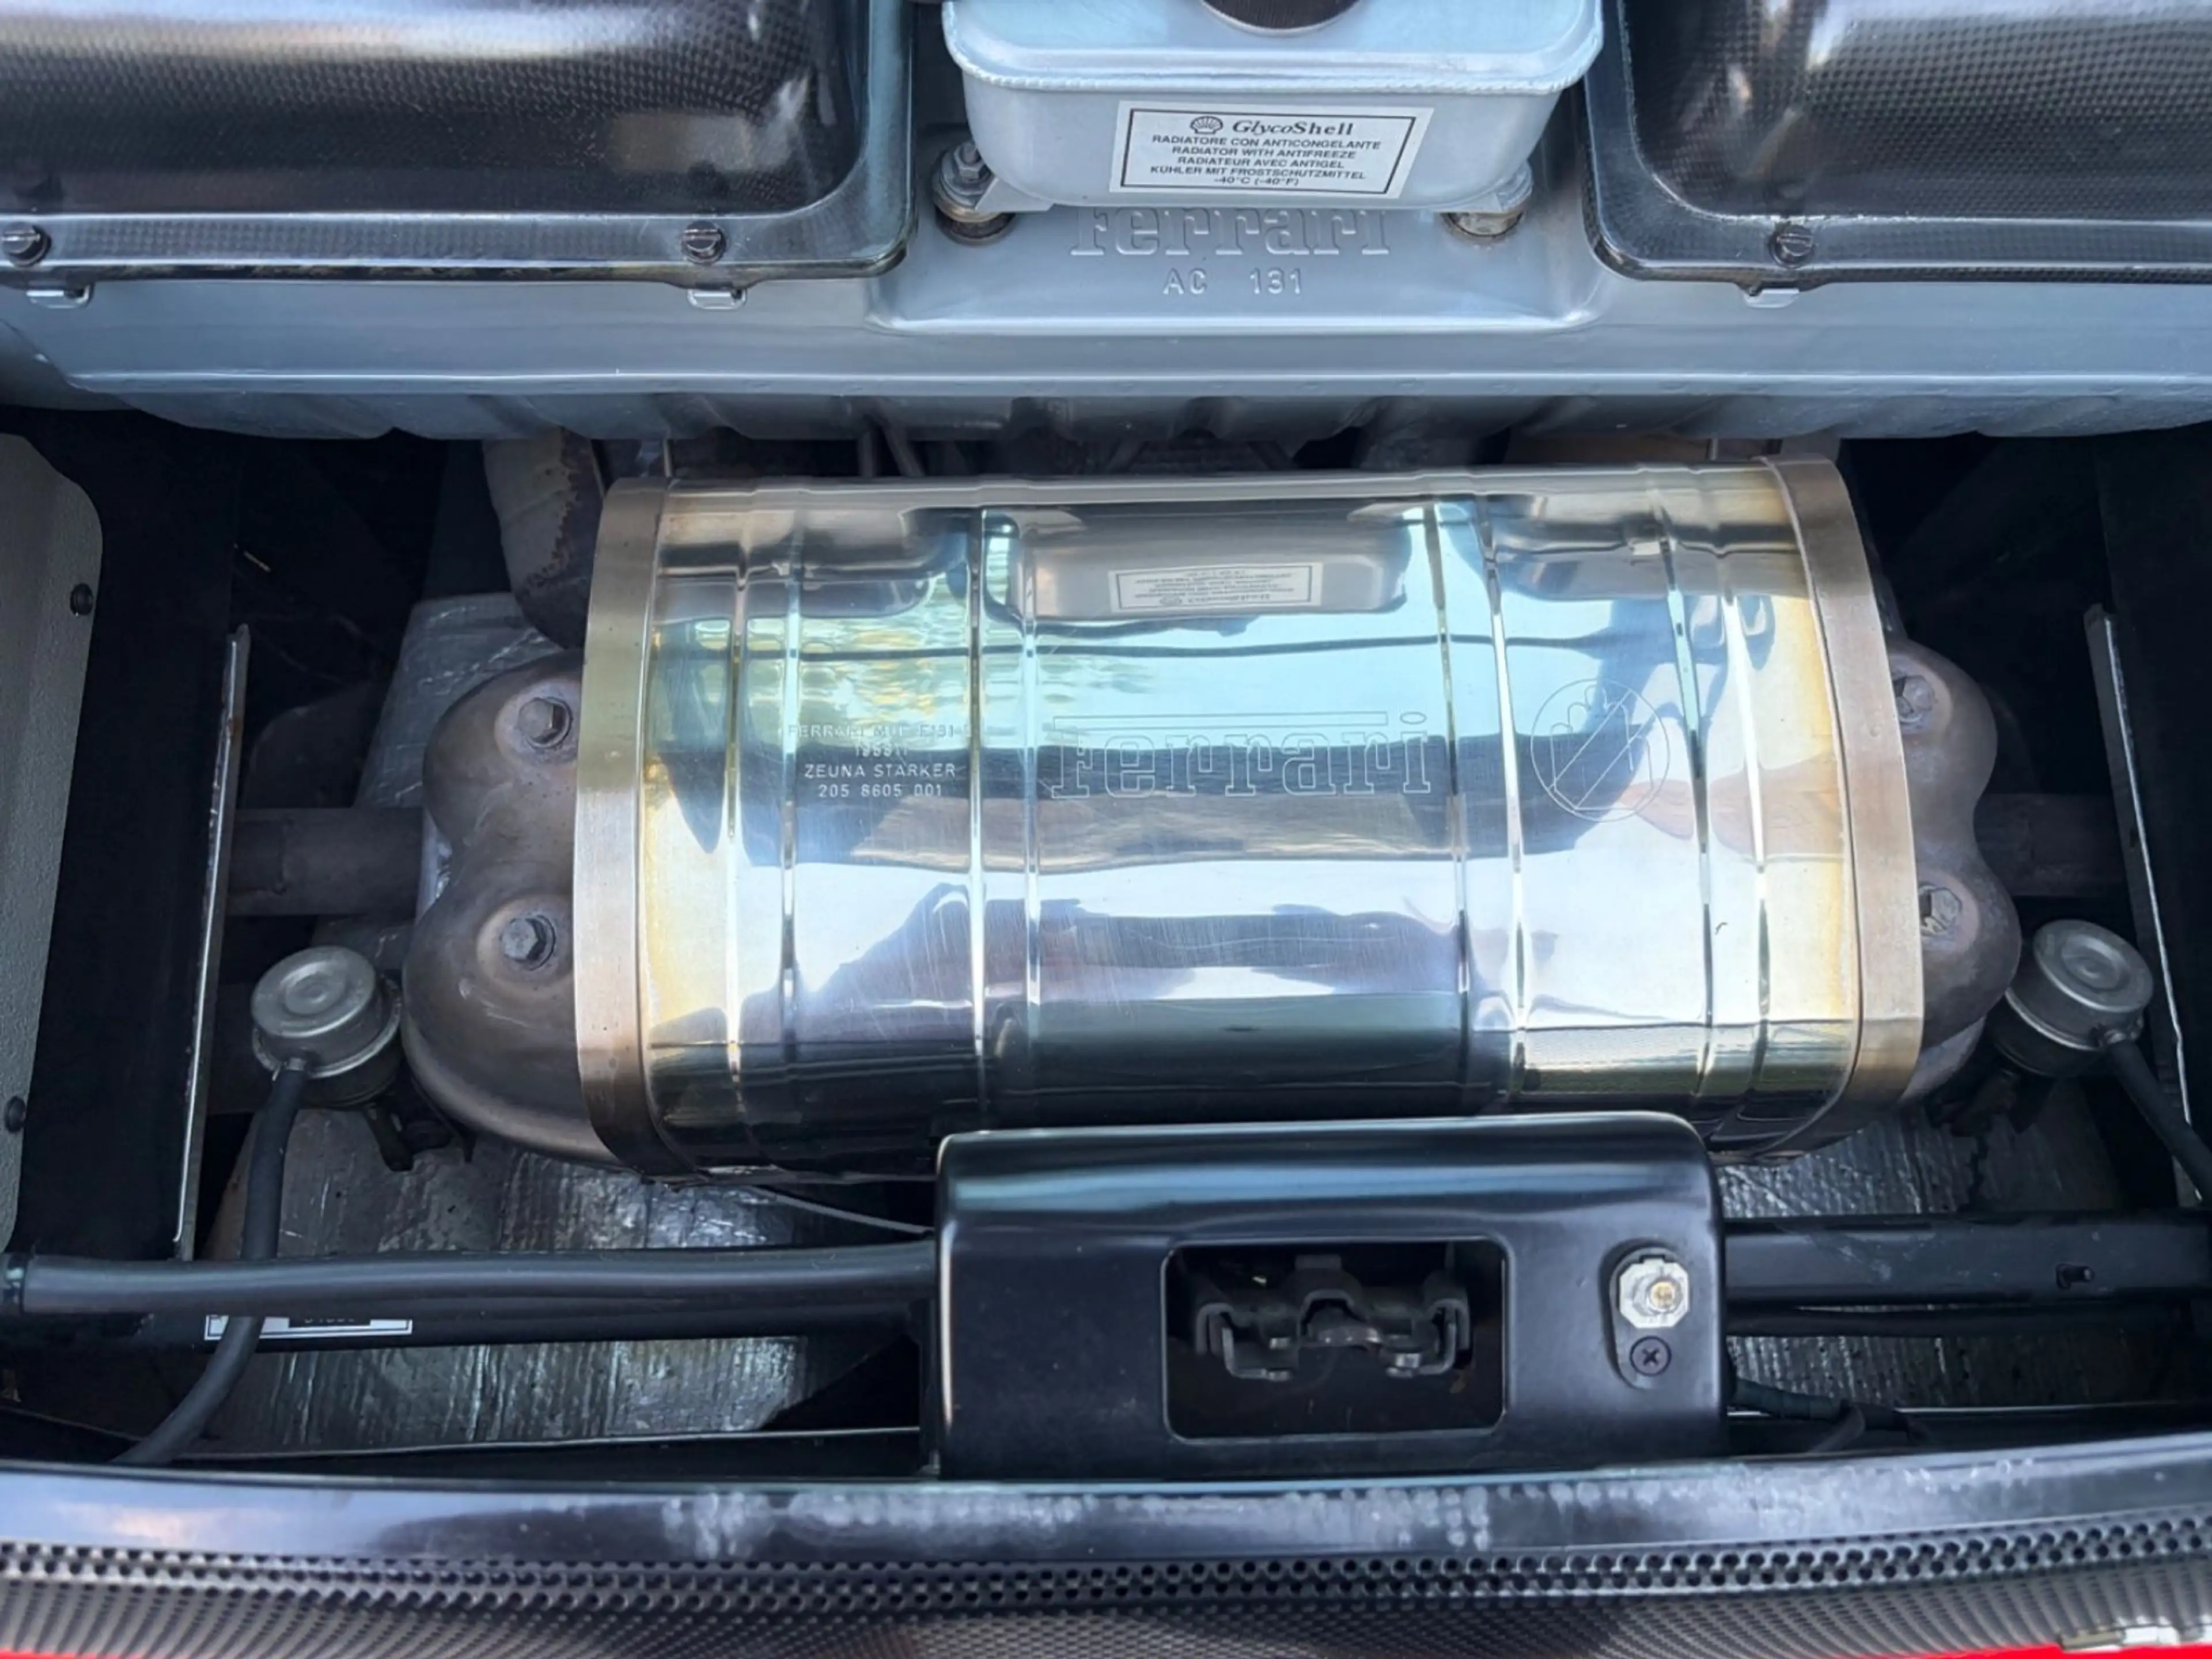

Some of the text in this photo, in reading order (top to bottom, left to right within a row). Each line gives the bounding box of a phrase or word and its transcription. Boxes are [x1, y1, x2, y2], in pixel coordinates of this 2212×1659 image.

[1233, 120, 1353, 136] GlycoShell
[1153, 135, 1381, 150] RADIATORE CON ANTICONGELANTE
[1172, 146, 1356, 159] RADIATOR WITH ANTIFREEZE
[1178, 156, 1344, 169] RADIATEUR AVEC ANTIGEL
[1205, 167, 1228, 176] MIT
[1229, 167, 1366, 180] FROSTSCHUTZMITTEL
[1162, 268, 1301, 294] AC 131
[1051, 712, 1431, 799] Ferrari
[804, 764, 865, 778] ZEUNA
[818, 784, 850, 798] 205
[914, 783, 942, 797] 001
